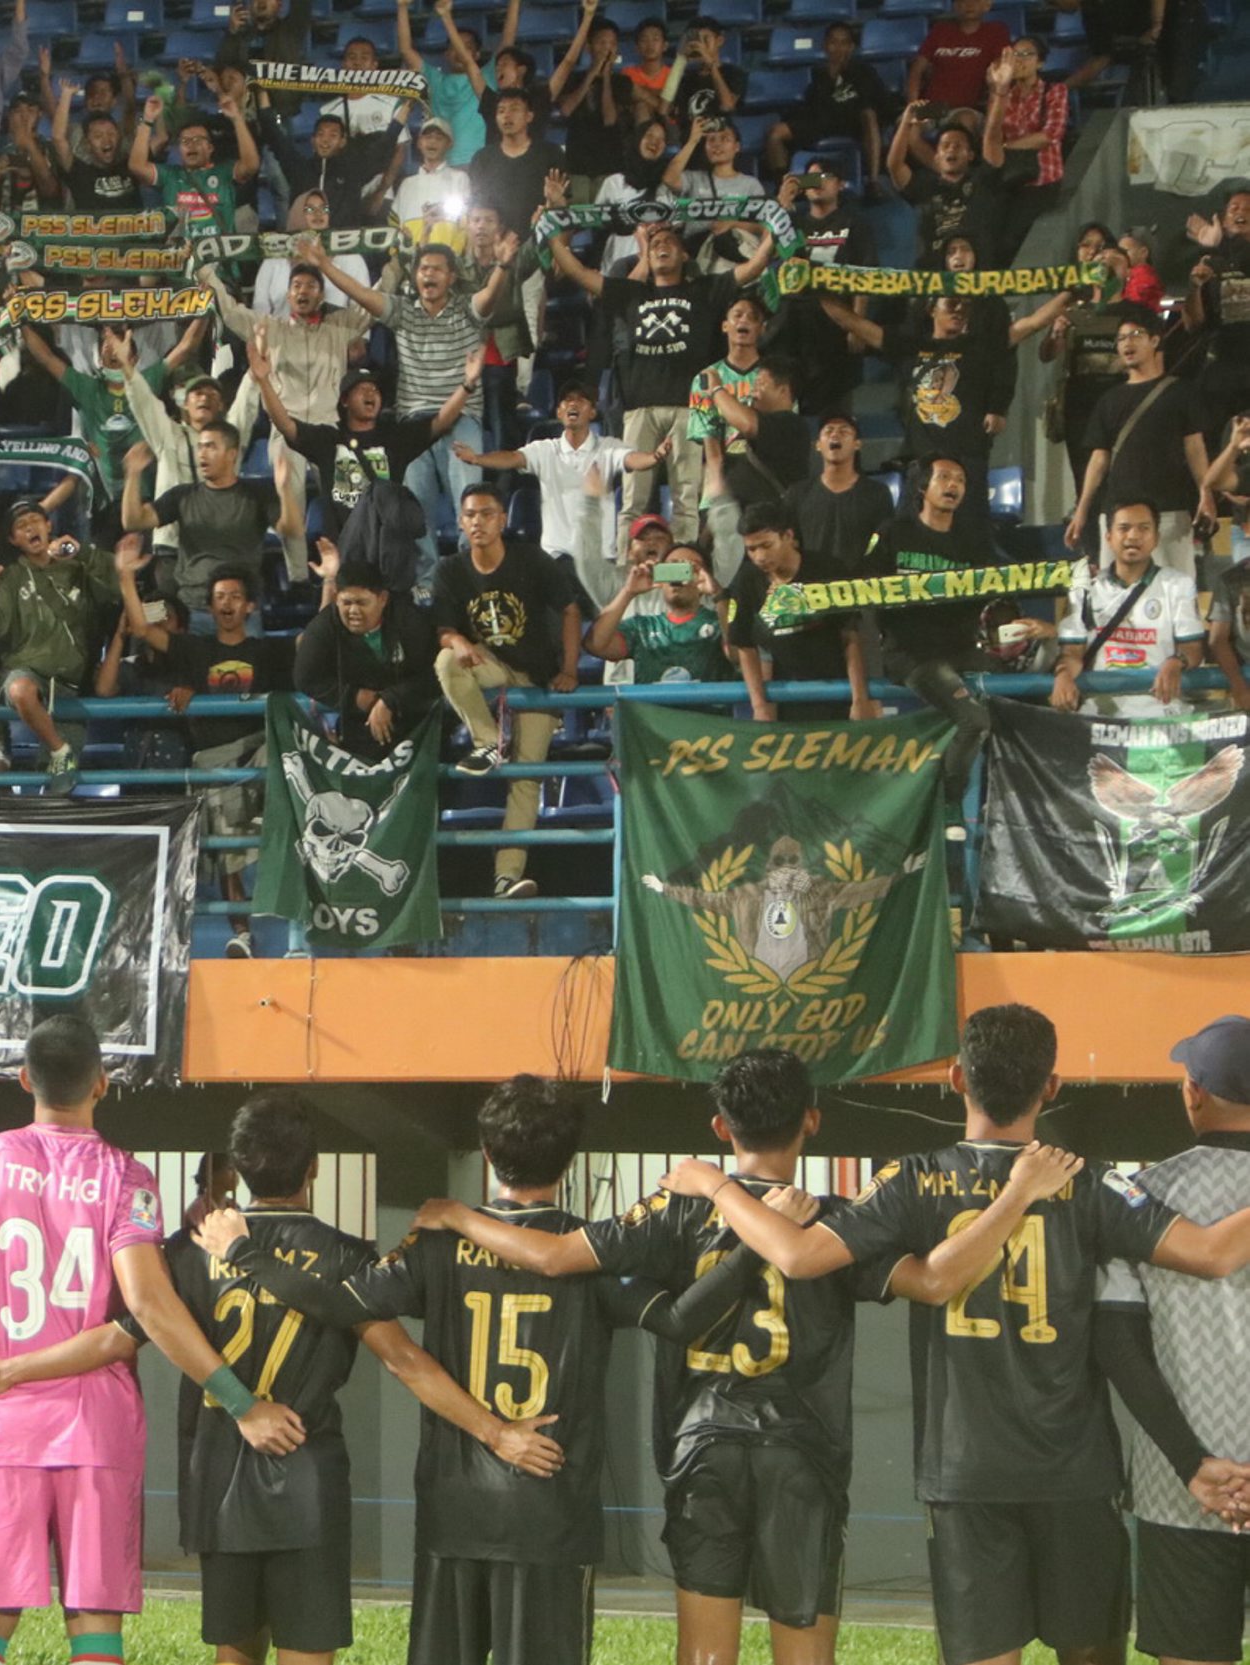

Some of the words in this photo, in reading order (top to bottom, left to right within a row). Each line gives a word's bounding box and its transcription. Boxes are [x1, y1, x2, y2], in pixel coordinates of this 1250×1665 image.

[253, 61, 298, 81] THE
[300, 65, 429, 91] WARRIORS
[22, 214, 69, 237] PSS
[70, 211, 166, 237] SLEMAN
[687, 199, 739, 219] OUR
[741, 199, 798, 248] PRIDE
[45, 245, 93, 268] PSS
[812, 266, 945, 295] PERSEBAYA
[954, 264, 1078, 296] SURABAYA
[7, 291, 68, 327] PSS
[76, 286, 215, 321] SLEMAN
[802, 573, 934, 611] BONEK
[943, 559, 1073, 599] MANIA
[312, 903, 380, 937] OYS
[702, 999, 792, 1034] ONLY
[796, 993, 866, 1031] GOD
[677, 1028, 745, 1062] CAN
[5, 1161, 53, 1196] TRY
[463, 1290, 553, 1422] 15
